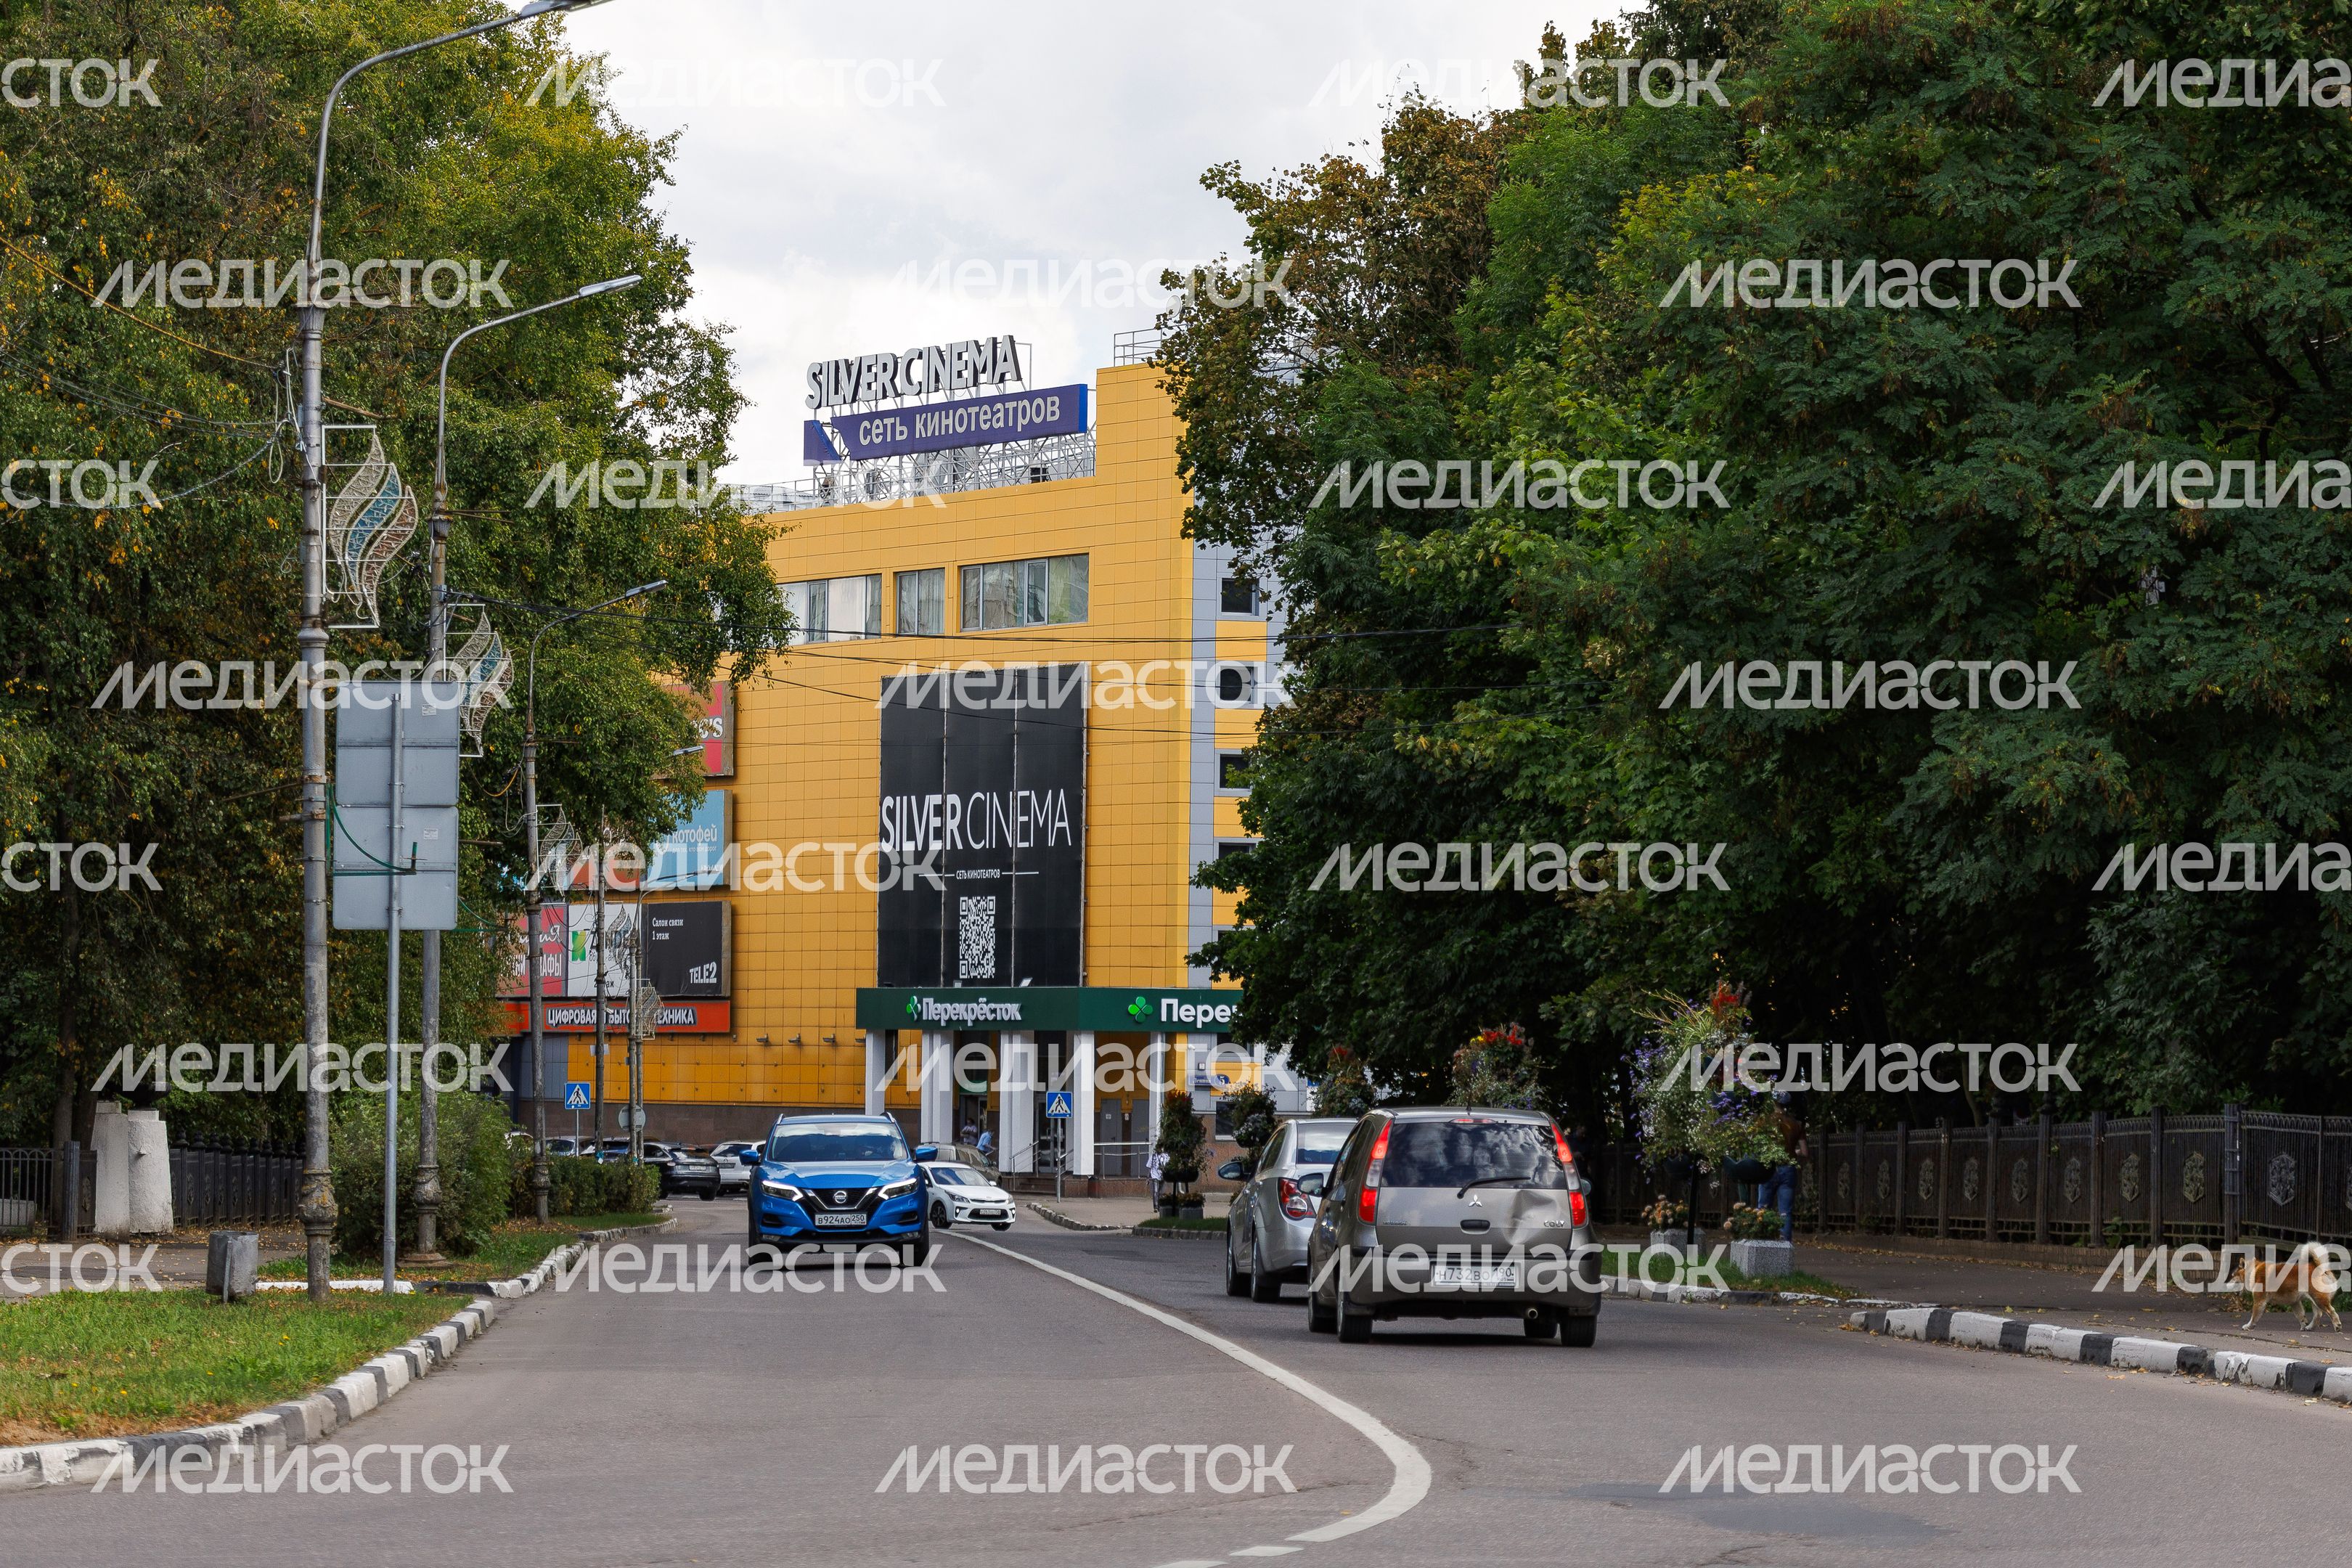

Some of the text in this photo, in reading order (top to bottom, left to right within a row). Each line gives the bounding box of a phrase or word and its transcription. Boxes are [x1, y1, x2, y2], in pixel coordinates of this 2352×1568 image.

[805, 335, 1023, 409] SILVER CINEMA
[859, 396, 1061, 446] сеть кинотеатров
[881, 788, 1071, 853] SILVER CINEMA
[956, 869, 1000, 880] СЕТЬ КИНОТЕАТРОВ
[652, 918, 669, 927] Салон
[652, 931, 669, 940] 1 этаж
[690, 961, 717, 984] TELE2
[548, 1008, 597, 1026] ЦИФРОВАЯ
[654, 1008, 694, 1024] ЕХНИКА
[922, 997, 1022, 1026] Перекрёсток
[1161, 998, 1237, 1028] Пере
[1220, 1076, 1225, 1085] 5
